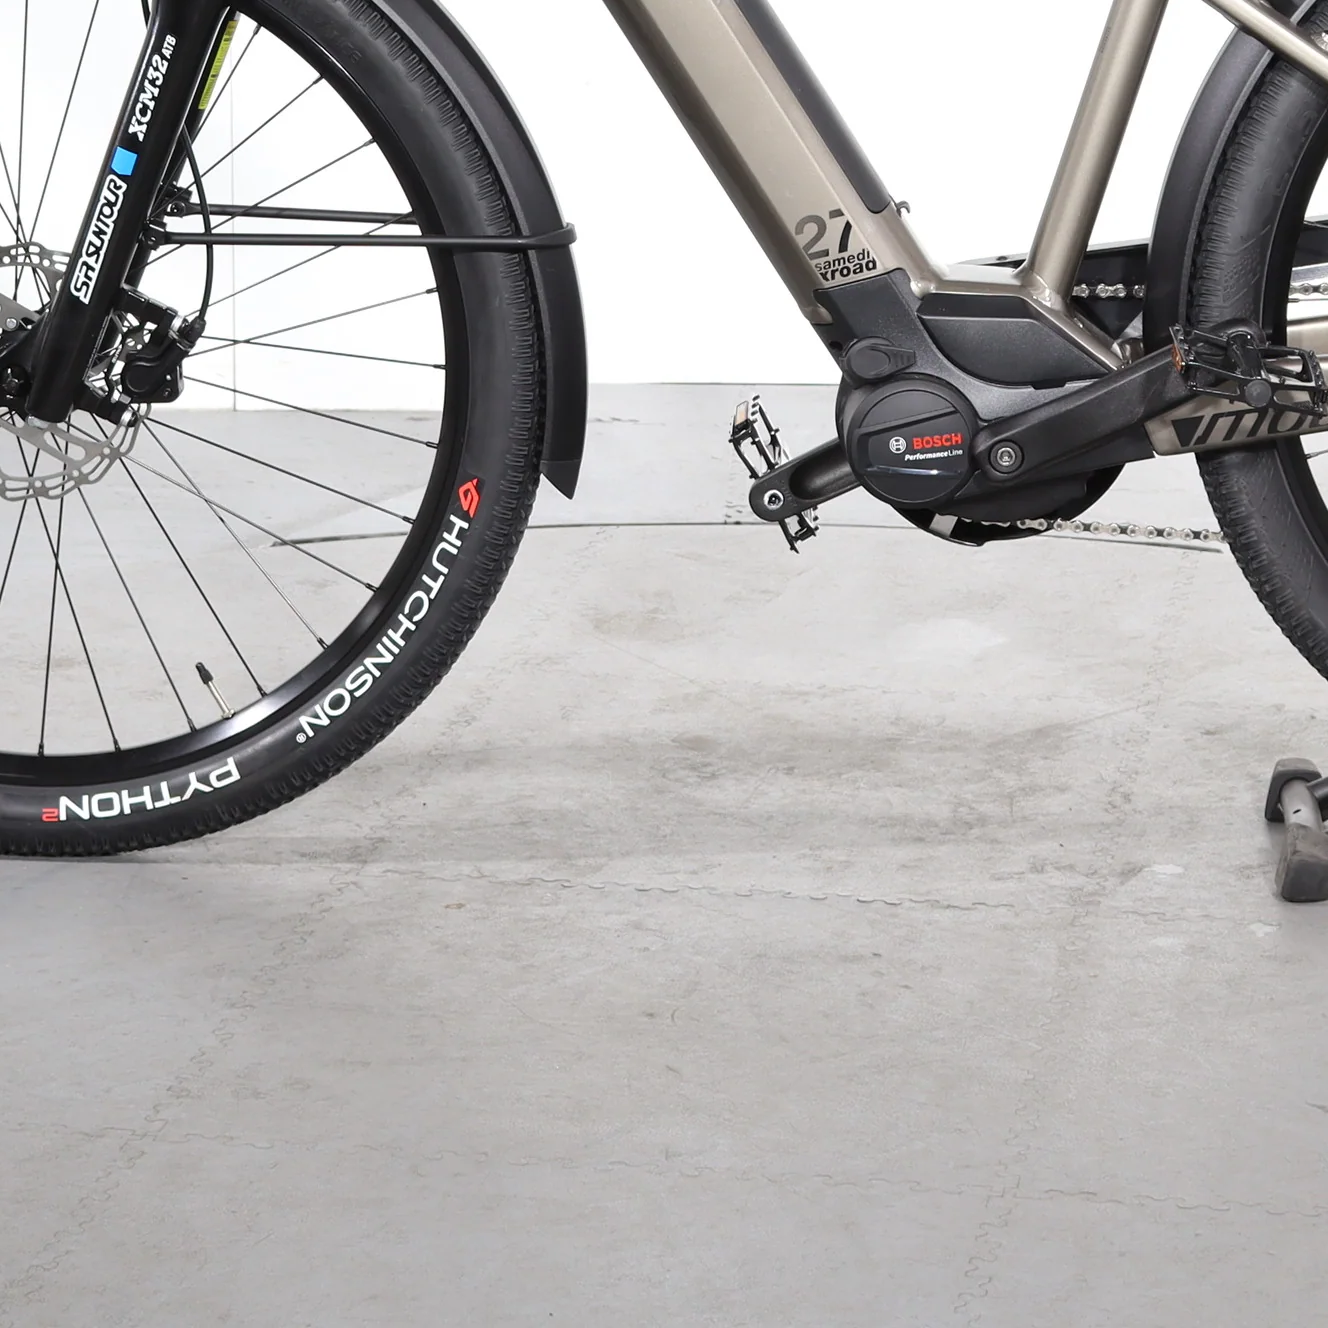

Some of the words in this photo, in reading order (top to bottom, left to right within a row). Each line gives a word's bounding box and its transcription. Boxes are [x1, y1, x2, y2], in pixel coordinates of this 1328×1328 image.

[128, 54, 169, 142] XCM32
[161, 34, 176, 60] ATB
[83, 173, 128, 264] SUNTOUR
[795, 208, 852, 261] 27
[814, 247, 871, 272] samedi
[819, 256, 877, 282] xroad
[912, 433, 963, 450] BOSCH
[904, 451, 949, 461] Performance
